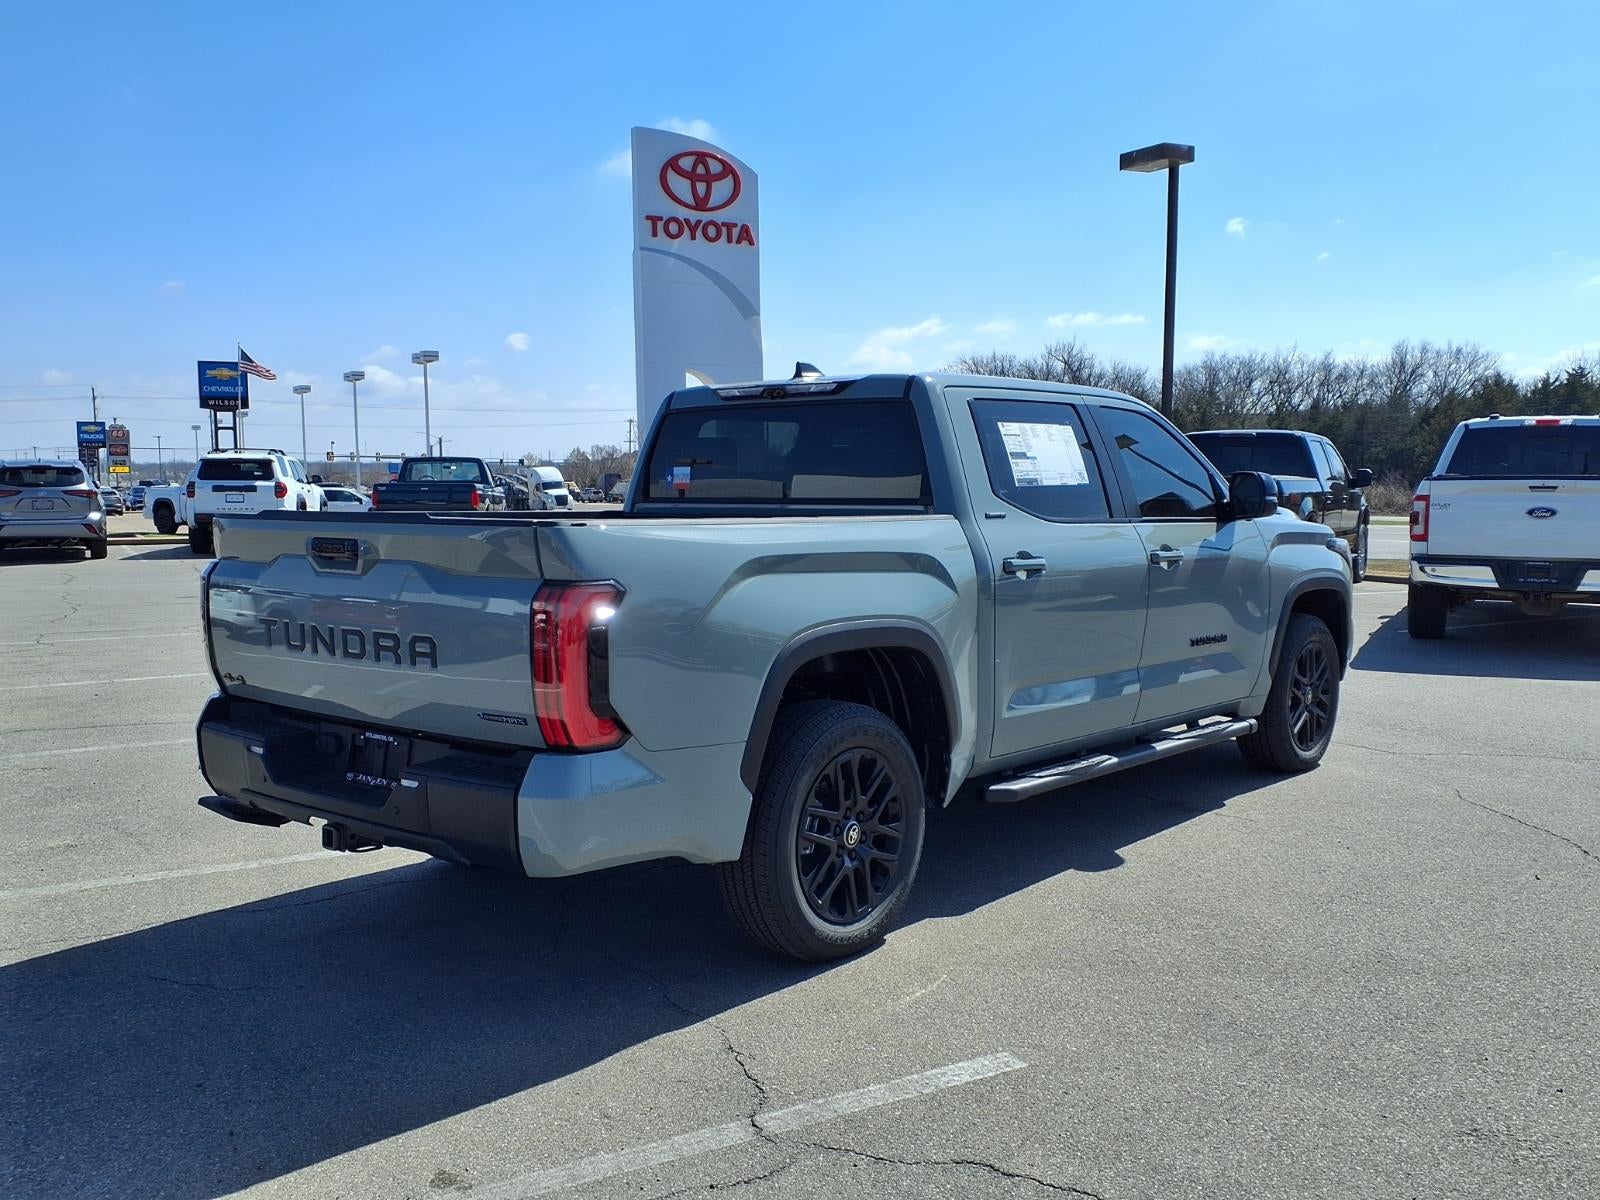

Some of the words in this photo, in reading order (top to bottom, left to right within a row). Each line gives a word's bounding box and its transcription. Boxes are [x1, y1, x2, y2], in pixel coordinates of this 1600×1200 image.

[645, 215, 755, 246] TOYOTA
[1532, 509, 1551, 518] Ford
[259, 616, 439, 669] TUNDRA
[356, 773, 388, 785] JANZEN
